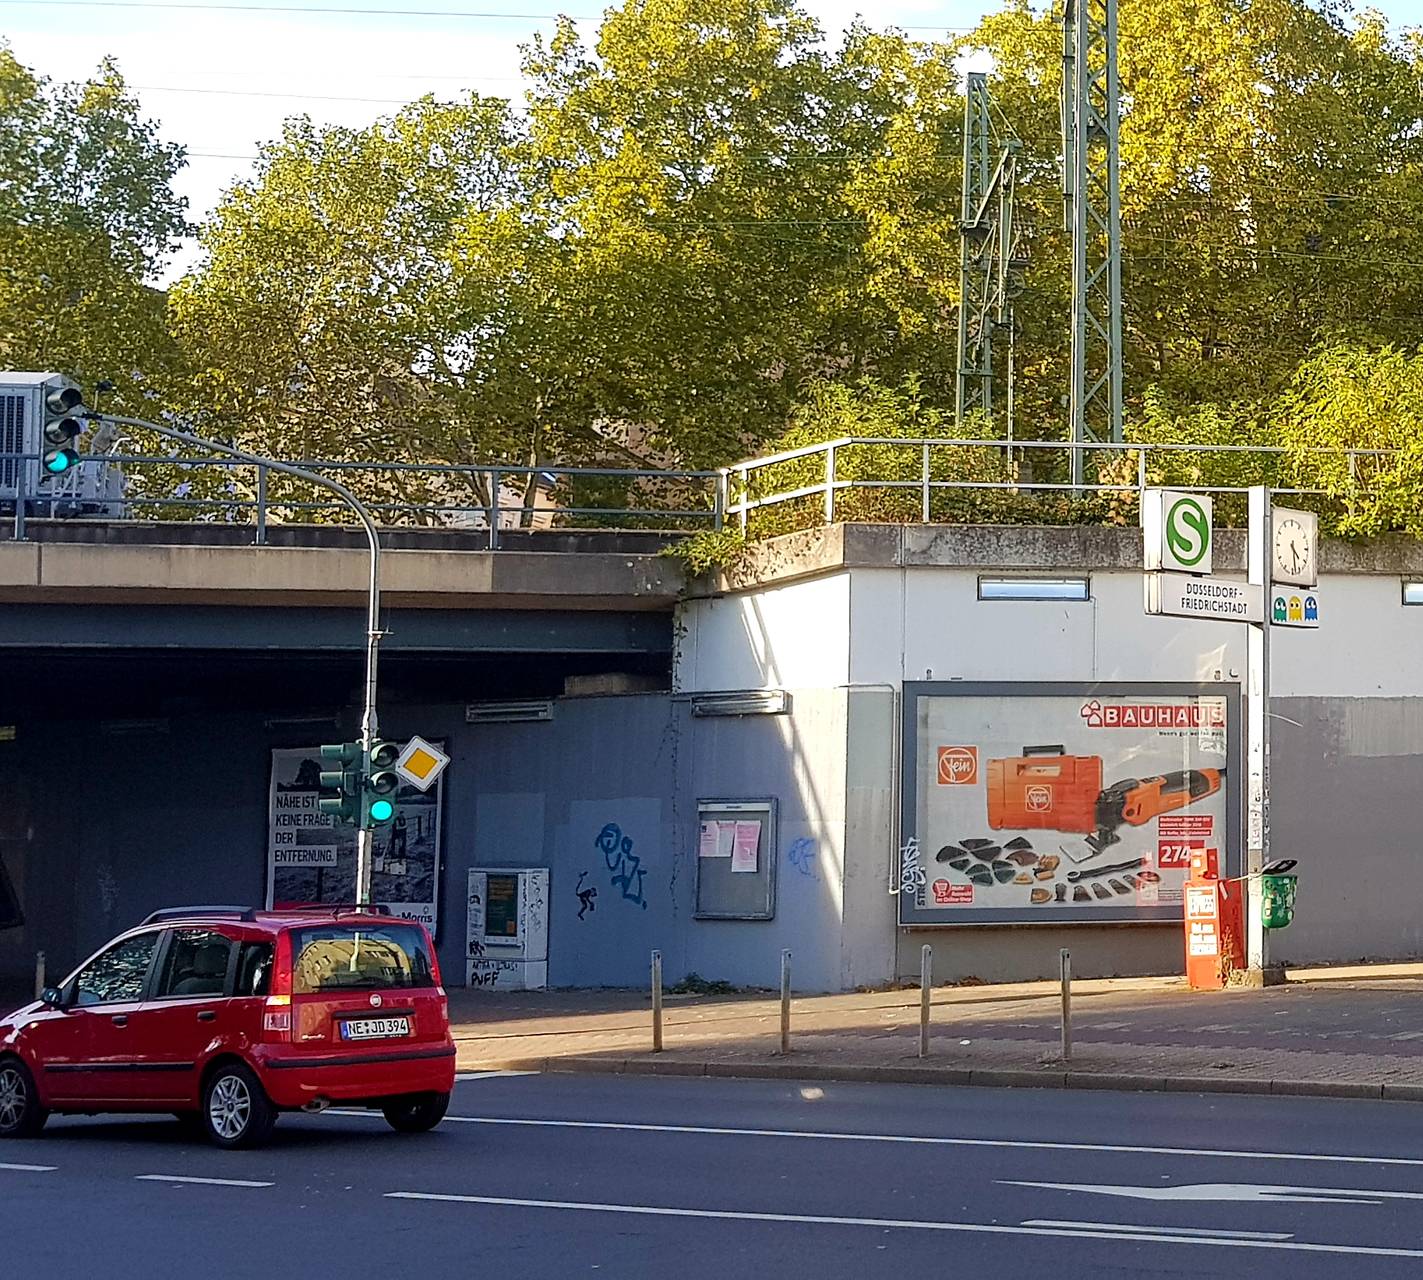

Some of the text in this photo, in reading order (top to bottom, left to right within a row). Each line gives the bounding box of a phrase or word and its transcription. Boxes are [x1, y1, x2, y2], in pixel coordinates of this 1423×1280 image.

[1173, 504, 1203, 560] S
[1186, 582, 1243, 599] DÜSSELDORF-
[1181, 597, 1248, 615] FRIEDRICHSTADT
[1105, 707, 1224, 727] BAUHAUS
[276, 795, 316, 808] NÄHE IST
[276, 813, 331, 827] KEINE FRAGE
[275, 832, 293, 844] DER
[274, 849, 335, 862] ENTFERNUNG.
[471, 971, 500, 987] PUFF
[348, 1020, 406, 1035] NE JD 394
